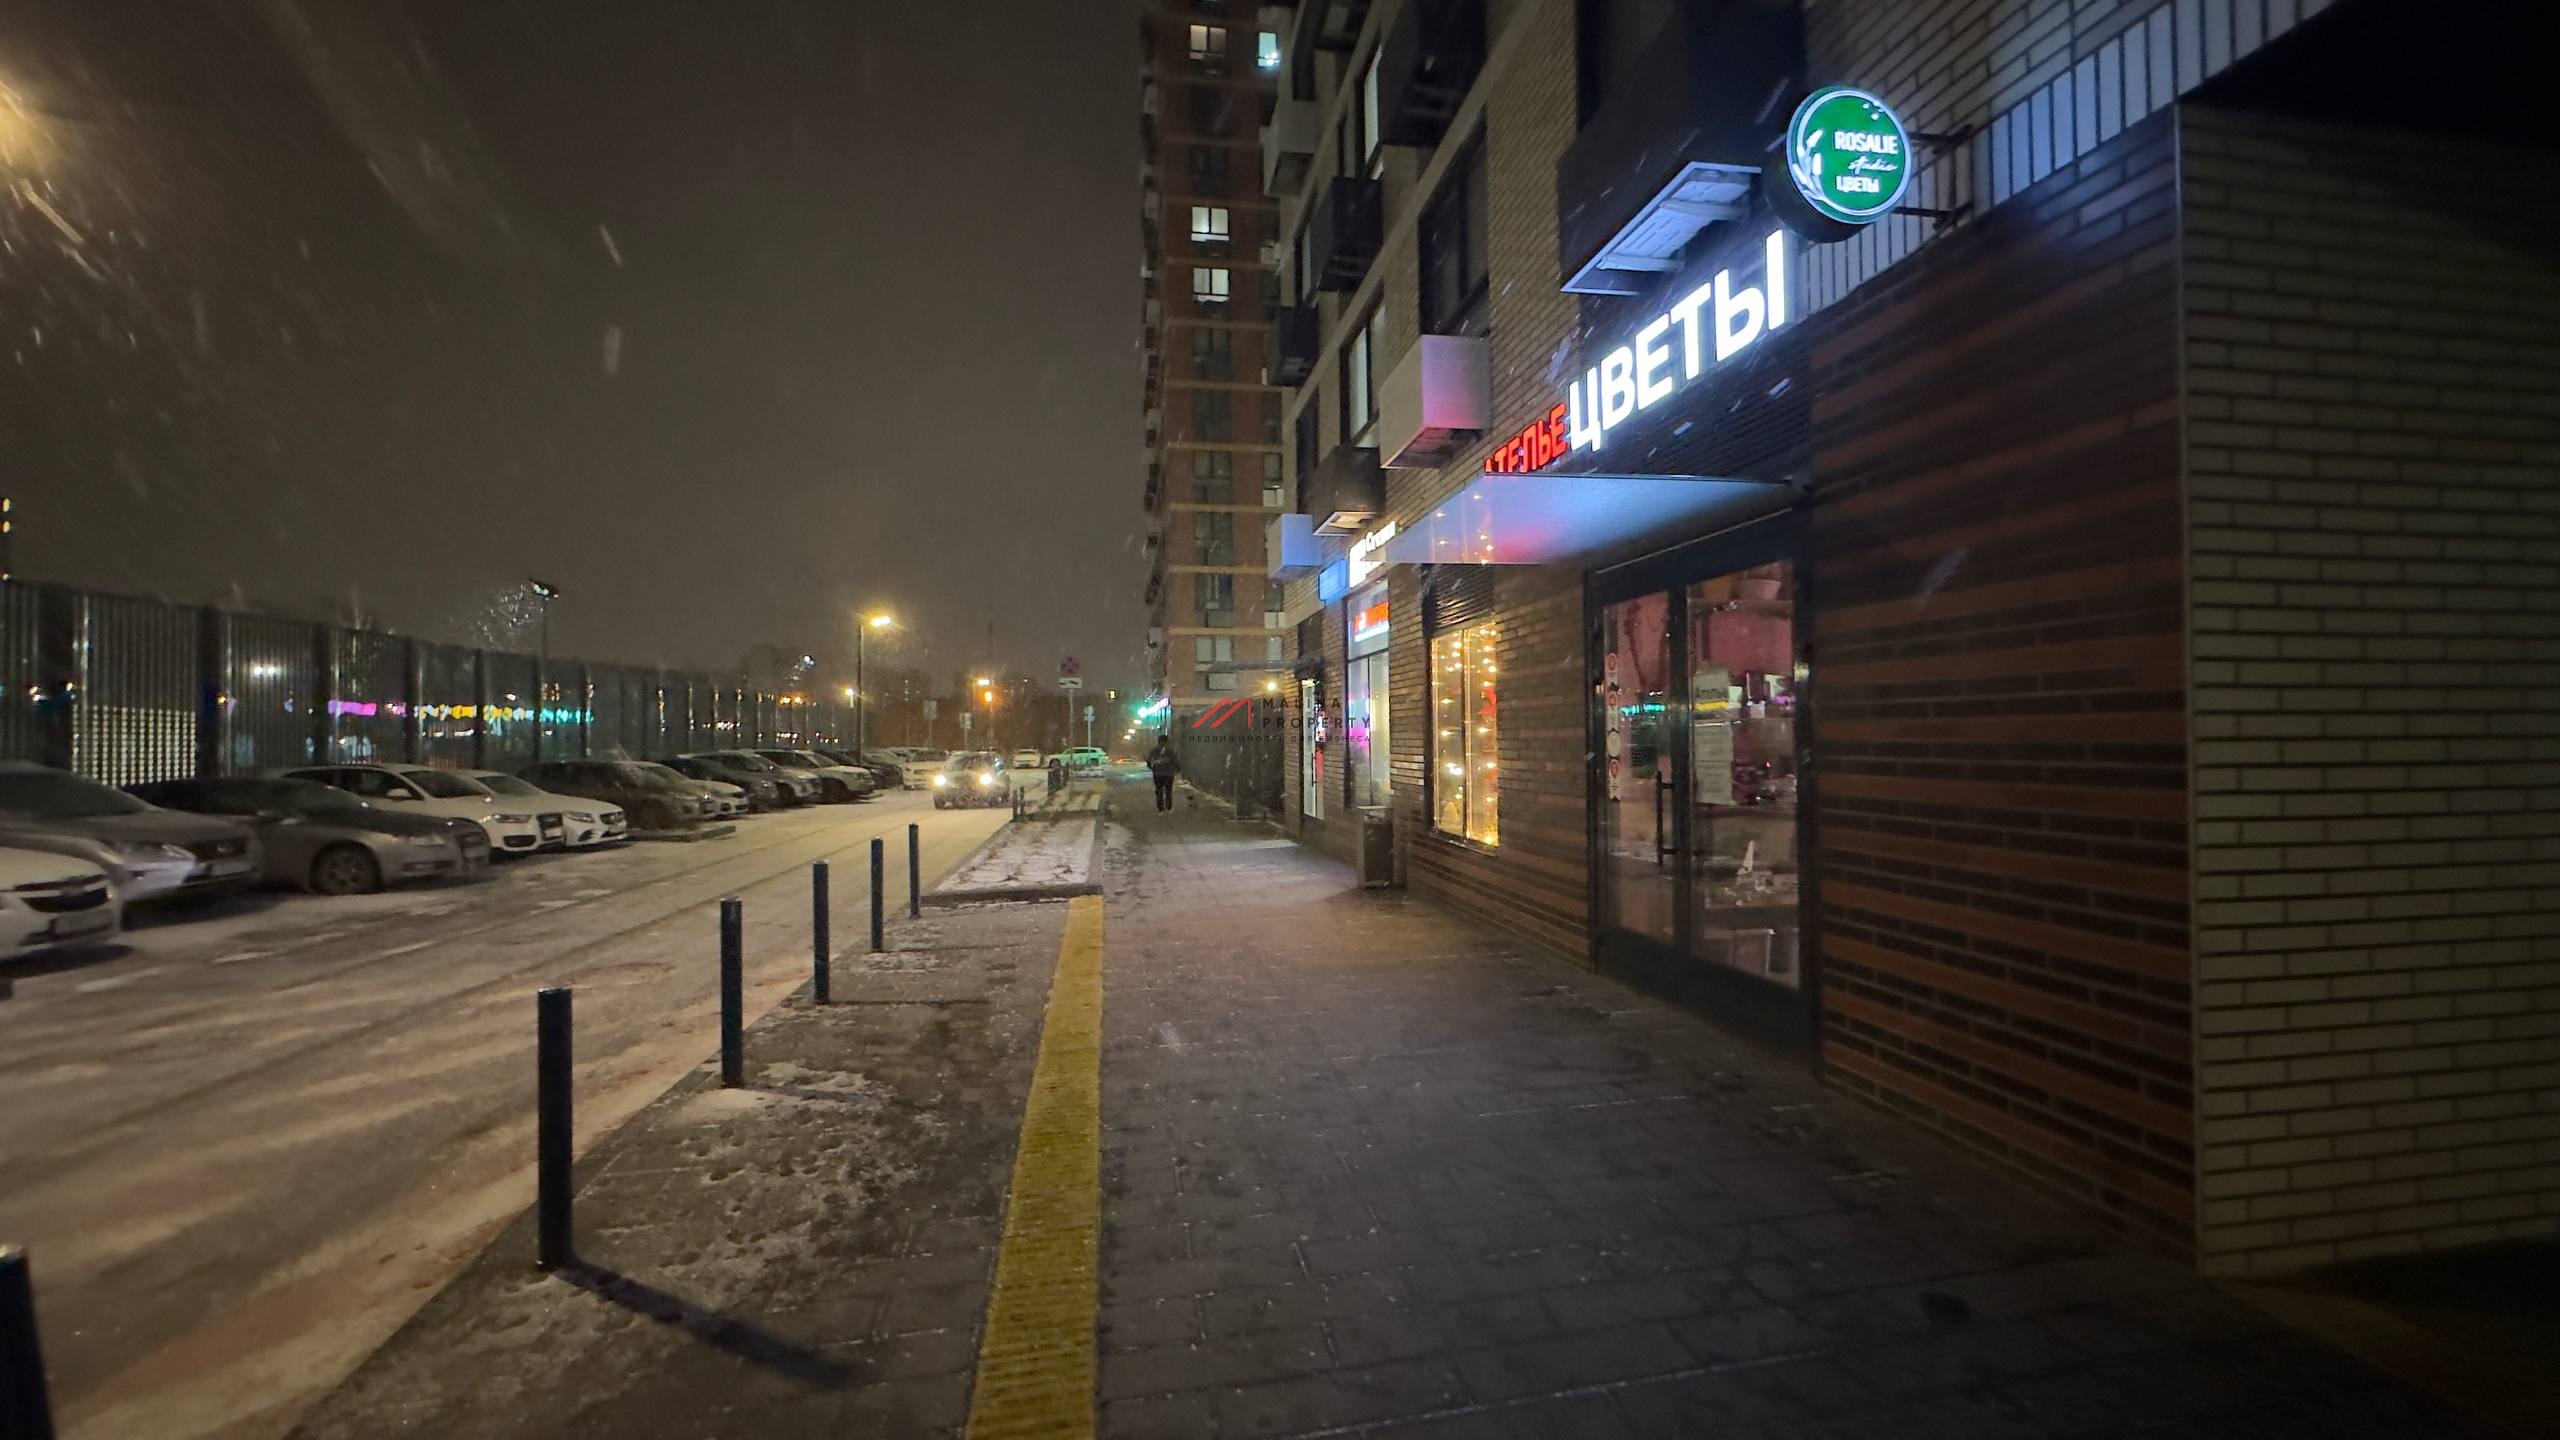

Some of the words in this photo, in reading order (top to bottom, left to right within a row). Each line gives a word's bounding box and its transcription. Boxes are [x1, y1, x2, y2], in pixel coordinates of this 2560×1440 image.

[1834, 131, 1898, 154] ROSALIE
[1836, 175, 1880, 193] ЦВЕТЫ
[1569, 229, 1785, 452] ЦВЕТЫ
